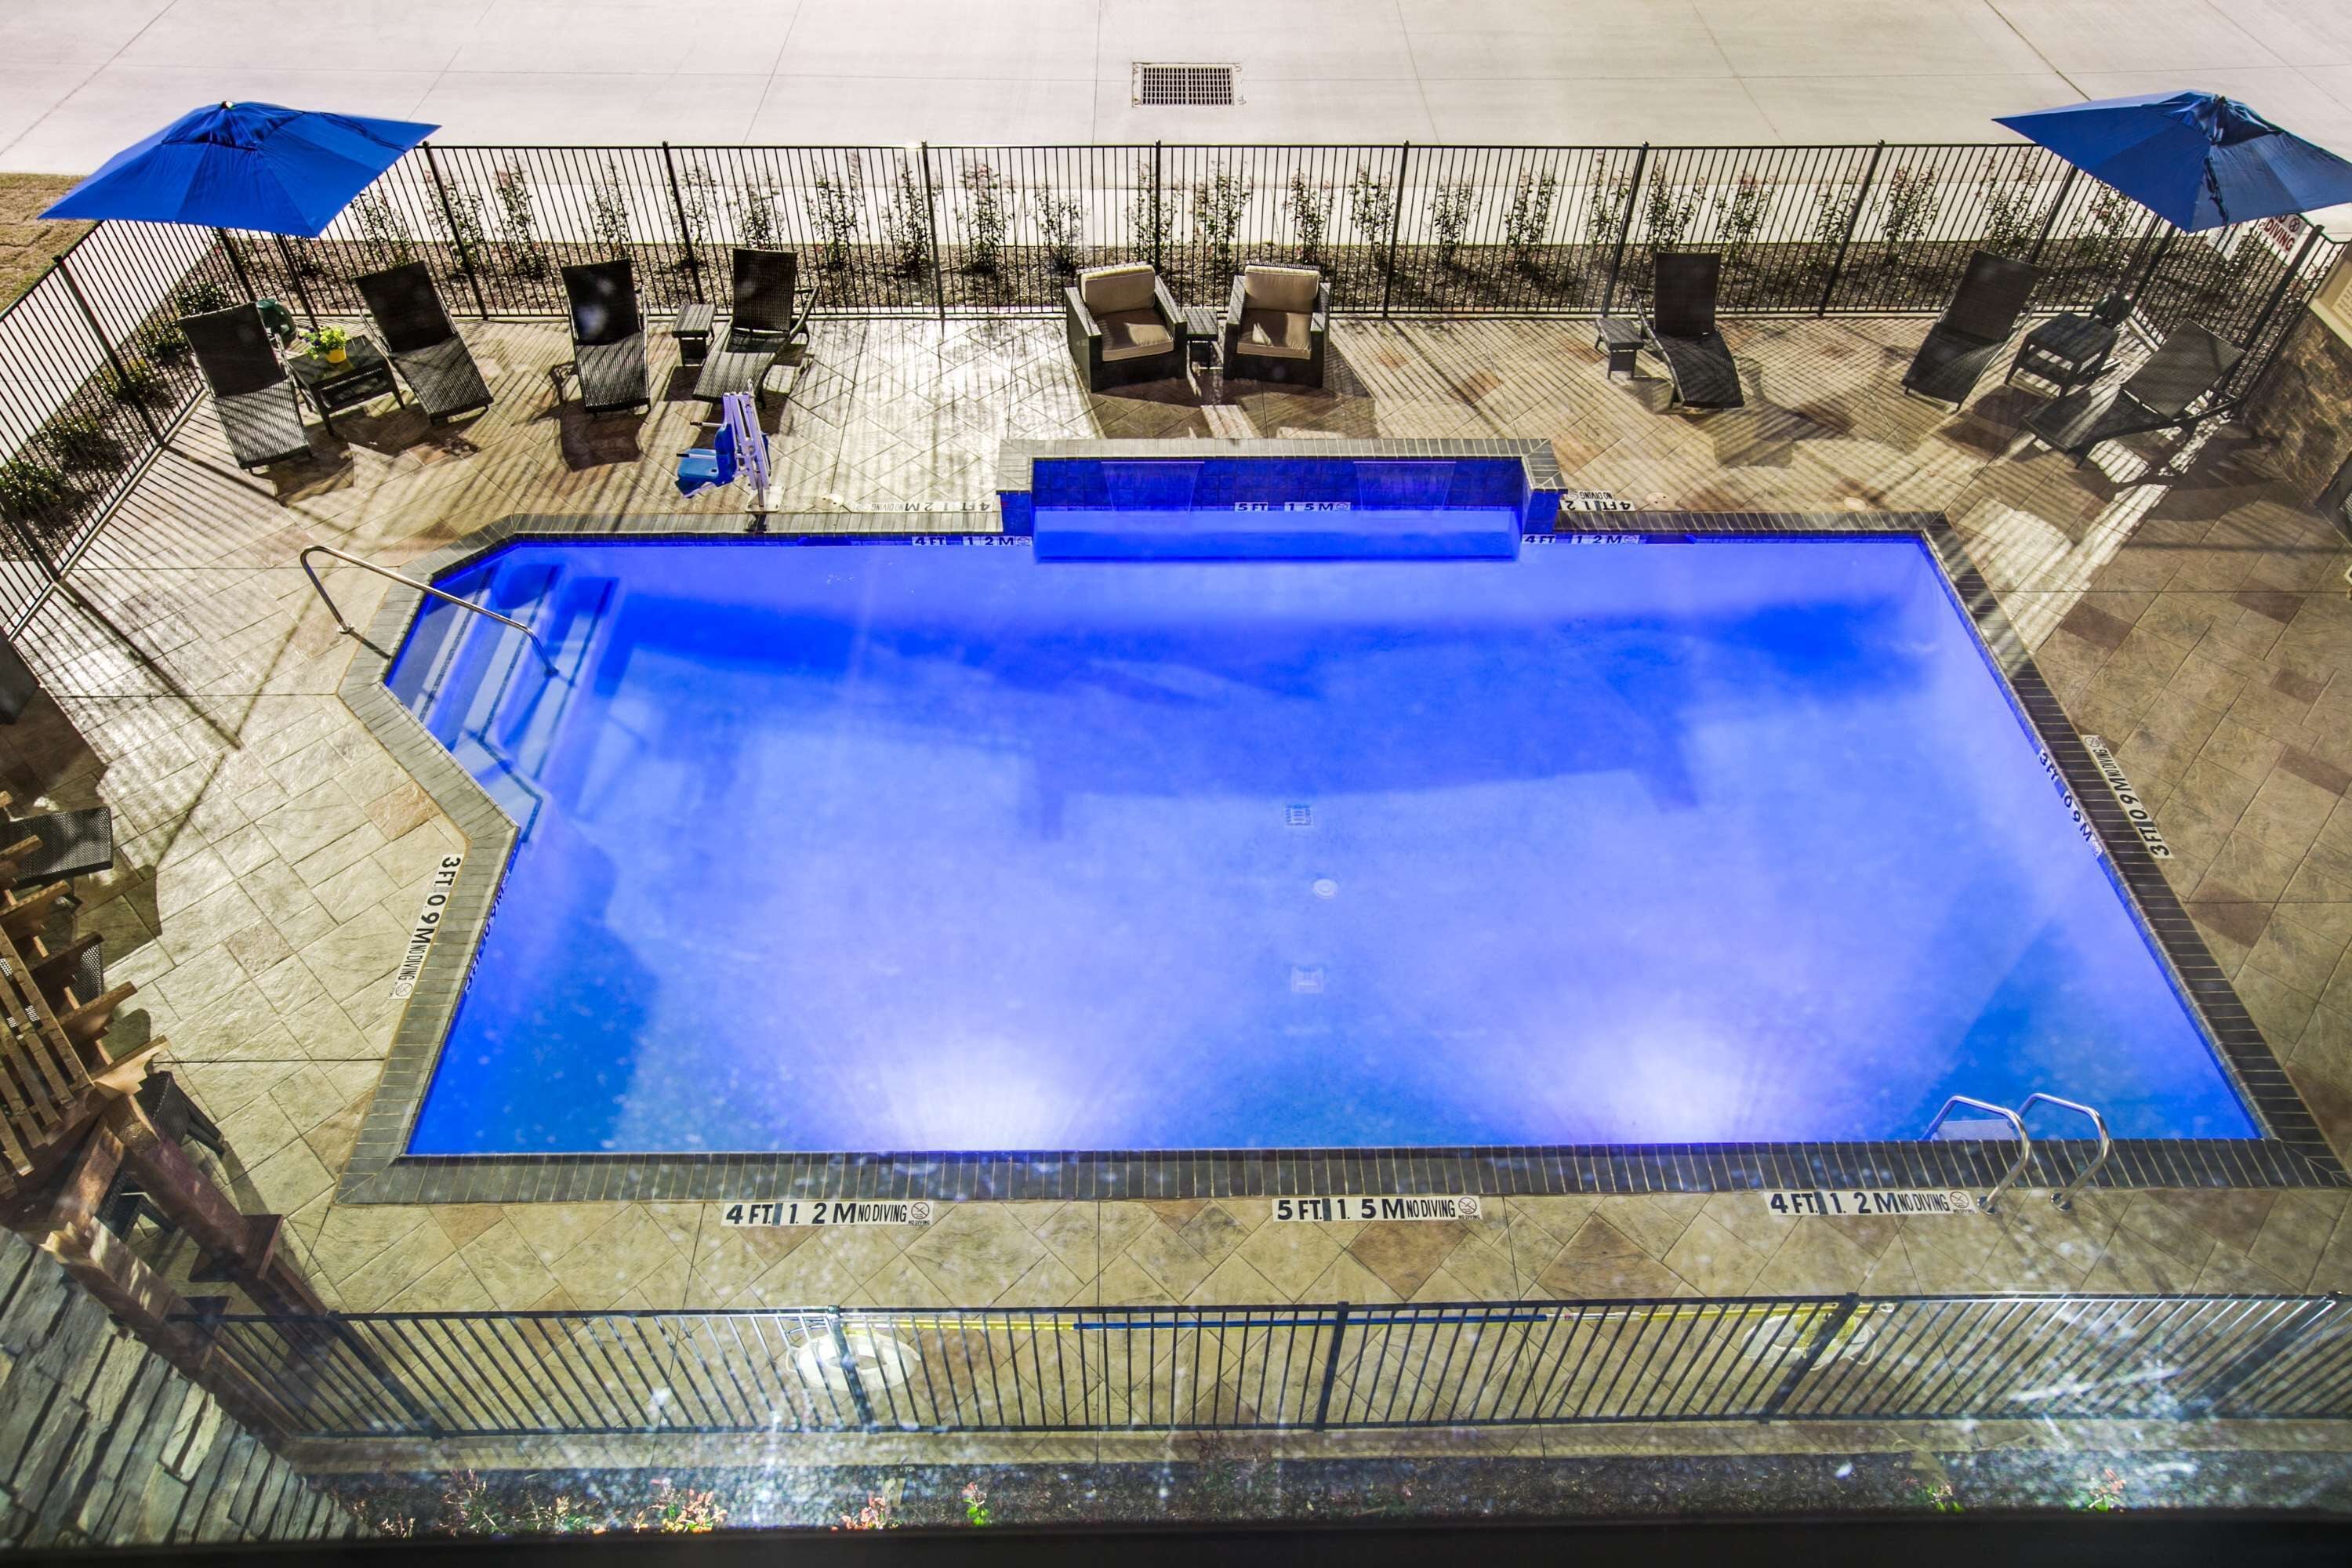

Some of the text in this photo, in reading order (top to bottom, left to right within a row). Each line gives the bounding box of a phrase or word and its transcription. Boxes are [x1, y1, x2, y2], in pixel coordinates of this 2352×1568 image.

[2264, 218, 2295, 251] DIVING
[1580, 492, 1613, 500] NO DIVING
[906, 503, 920, 511] M
[1238, 503, 1248, 511] 5
[1567, 500, 1577, 510] 2
[914, 536, 925, 545] 4
[929, 536, 945, 545] FT
[984, 536, 994, 545] 2
[999, 536, 1014, 545] M
[2039, 753, 2048, 766] 3
[2092, 748, 2116, 768] DIVING
[2108, 778, 2132, 791] M
[2120, 794, 2139, 804] 9
[2150, 844, 2169, 856] 3
[442, 857, 461, 868] 3
[420, 912, 440, 924] 9
[411, 927, 435, 943] M
[408, 944, 427, 955] NO
[397, 955, 423, 981] DIVING
[1277, 1200, 1293, 1220] 5
[1381, 1198, 1406, 1219] M
[1406, 1199, 1420, 1218] NO
[1421, 1199, 1456, 1218] DIVING
[1770, 1192, 1788, 1213] 4
[1872, 1192, 1900, 1214] M
[1897, 1193, 1913, 1212] NO
[1913, 1192, 1950, 1212] DIVING
[726, 1204, 742, 1224] 4
[833, 1203, 857, 1224] M
[858, 1204, 871, 1222] NO
[873, 1204, 907, 1222] DIVING
